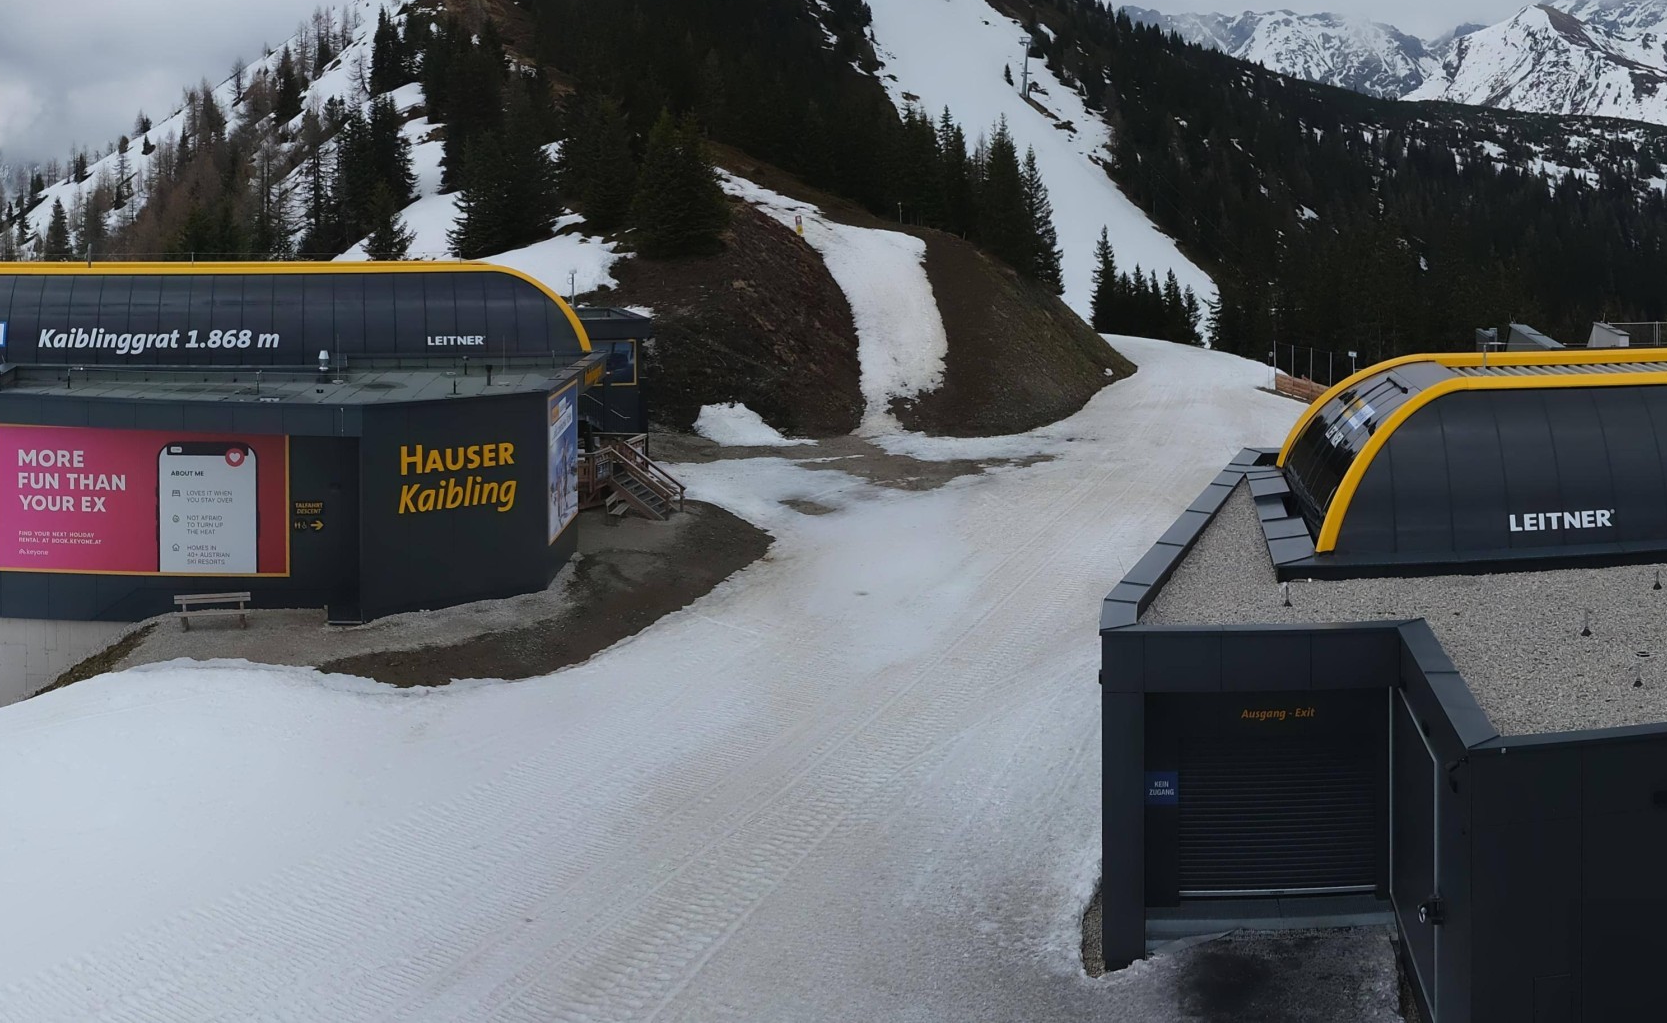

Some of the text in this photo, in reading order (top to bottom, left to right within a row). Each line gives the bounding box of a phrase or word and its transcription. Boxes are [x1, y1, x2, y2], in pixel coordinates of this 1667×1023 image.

[38, 328, 280, 354] Kaiblinggrat 1.868 m
[427, 336, 484, 346] LEITNER
[18, 449, 84, 468] MORE
[400, 442, 515, 476] HAUSER
[18, 472, 126, 491] FUN THAN
[19, 495, 106, 512] YOUR EX
[398, 476, 517, 514] Kaibling
[1509, 509, 1613, 532] LEITNER
[26, 549, 49, 557] keyone
[1241, 708, 1287, 721] Ausgang
[1295, 707, 1316, 718] Exit
[1149, 788, 1175, 796] ZUGANG
[1154, 780, 1169, 788] KEIN
